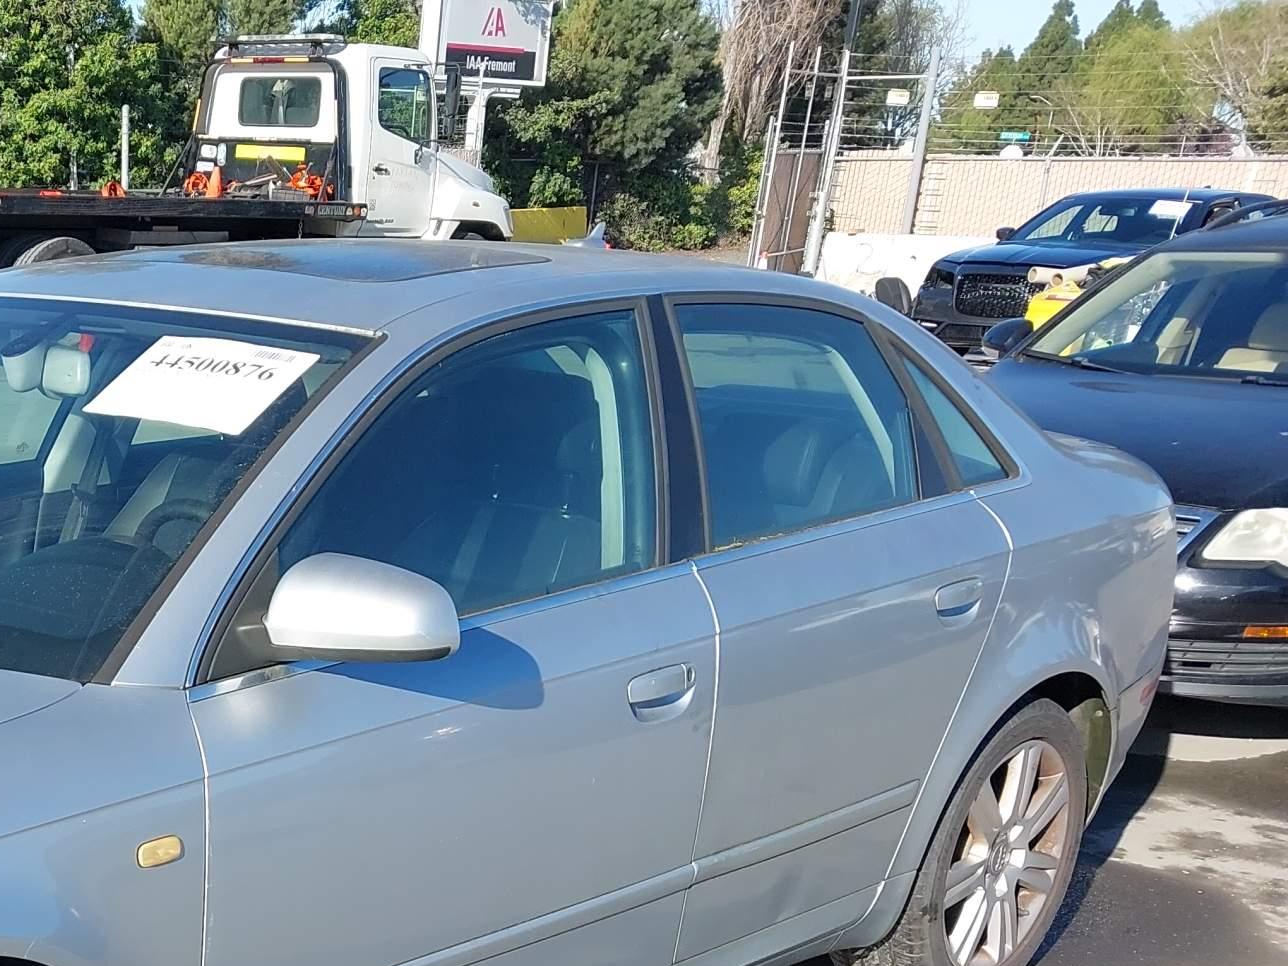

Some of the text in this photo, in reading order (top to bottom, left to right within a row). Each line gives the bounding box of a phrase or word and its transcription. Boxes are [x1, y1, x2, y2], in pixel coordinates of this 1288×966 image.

[466, 55, 516, 73] IAA Fremont
[150, 353, 275, 381] 44500876
